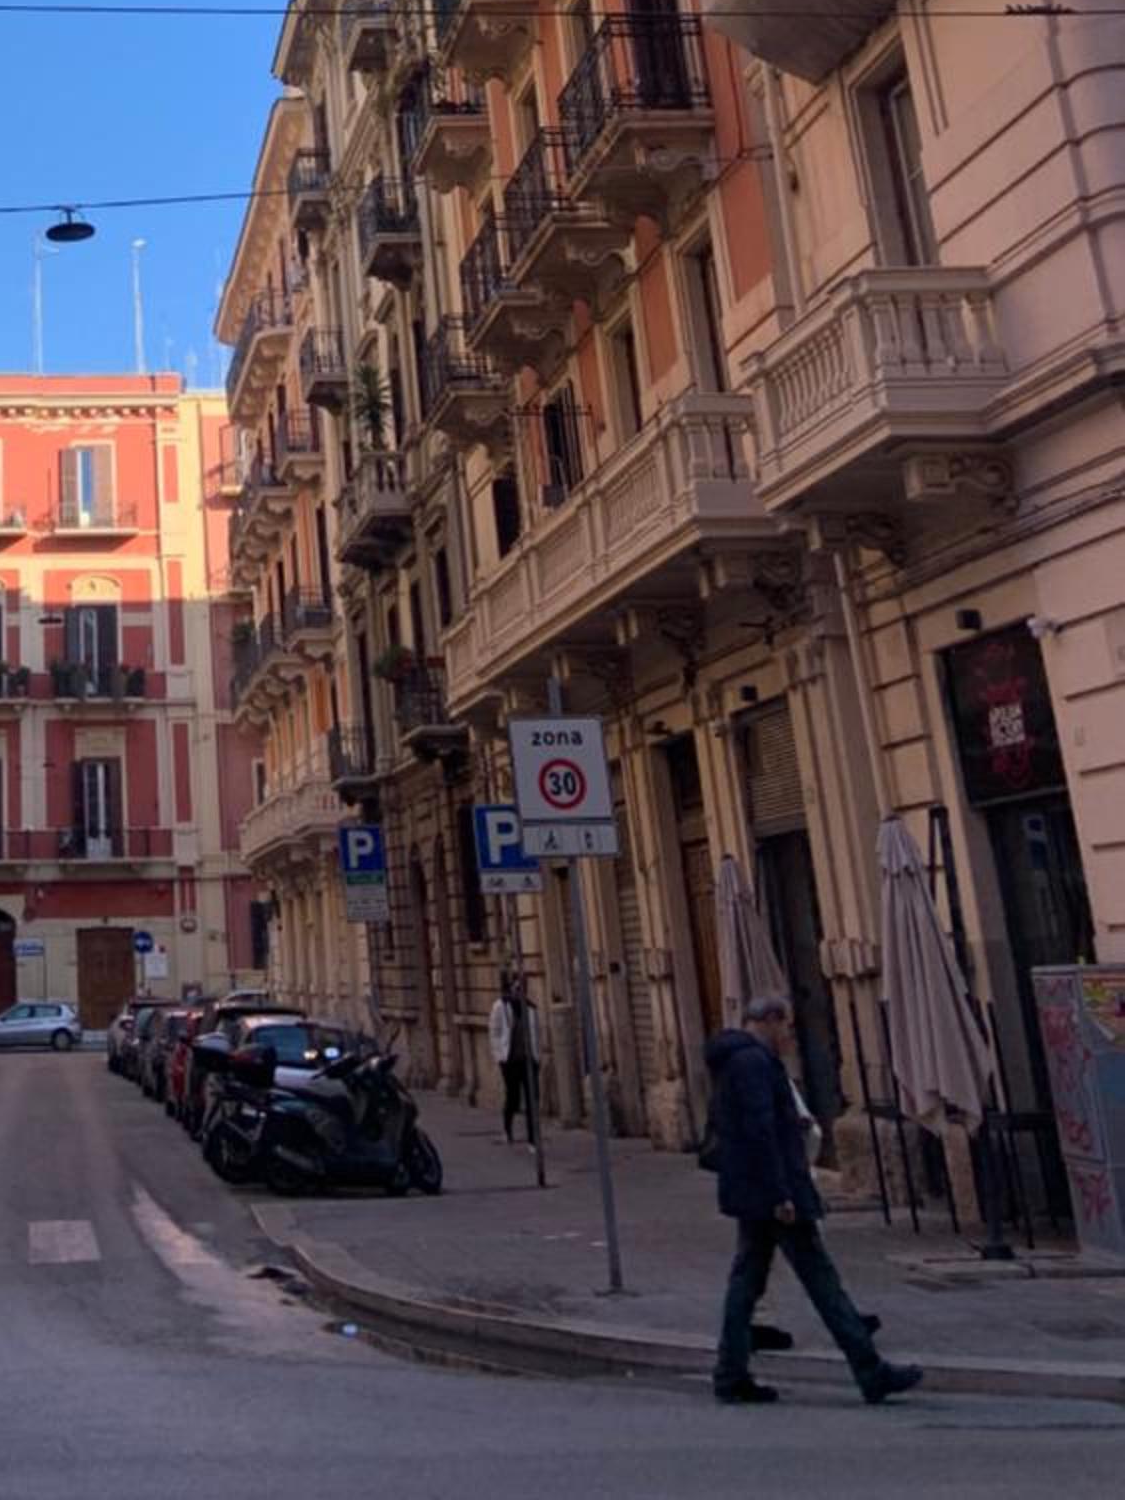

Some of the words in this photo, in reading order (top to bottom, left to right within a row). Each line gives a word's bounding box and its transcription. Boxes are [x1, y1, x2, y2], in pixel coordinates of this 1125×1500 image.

[531, 730, 583, 747] zona
[548, 772, 577, 796] 30
[348, 830, 373, 869] P
[485, 811, 519, 864] P
